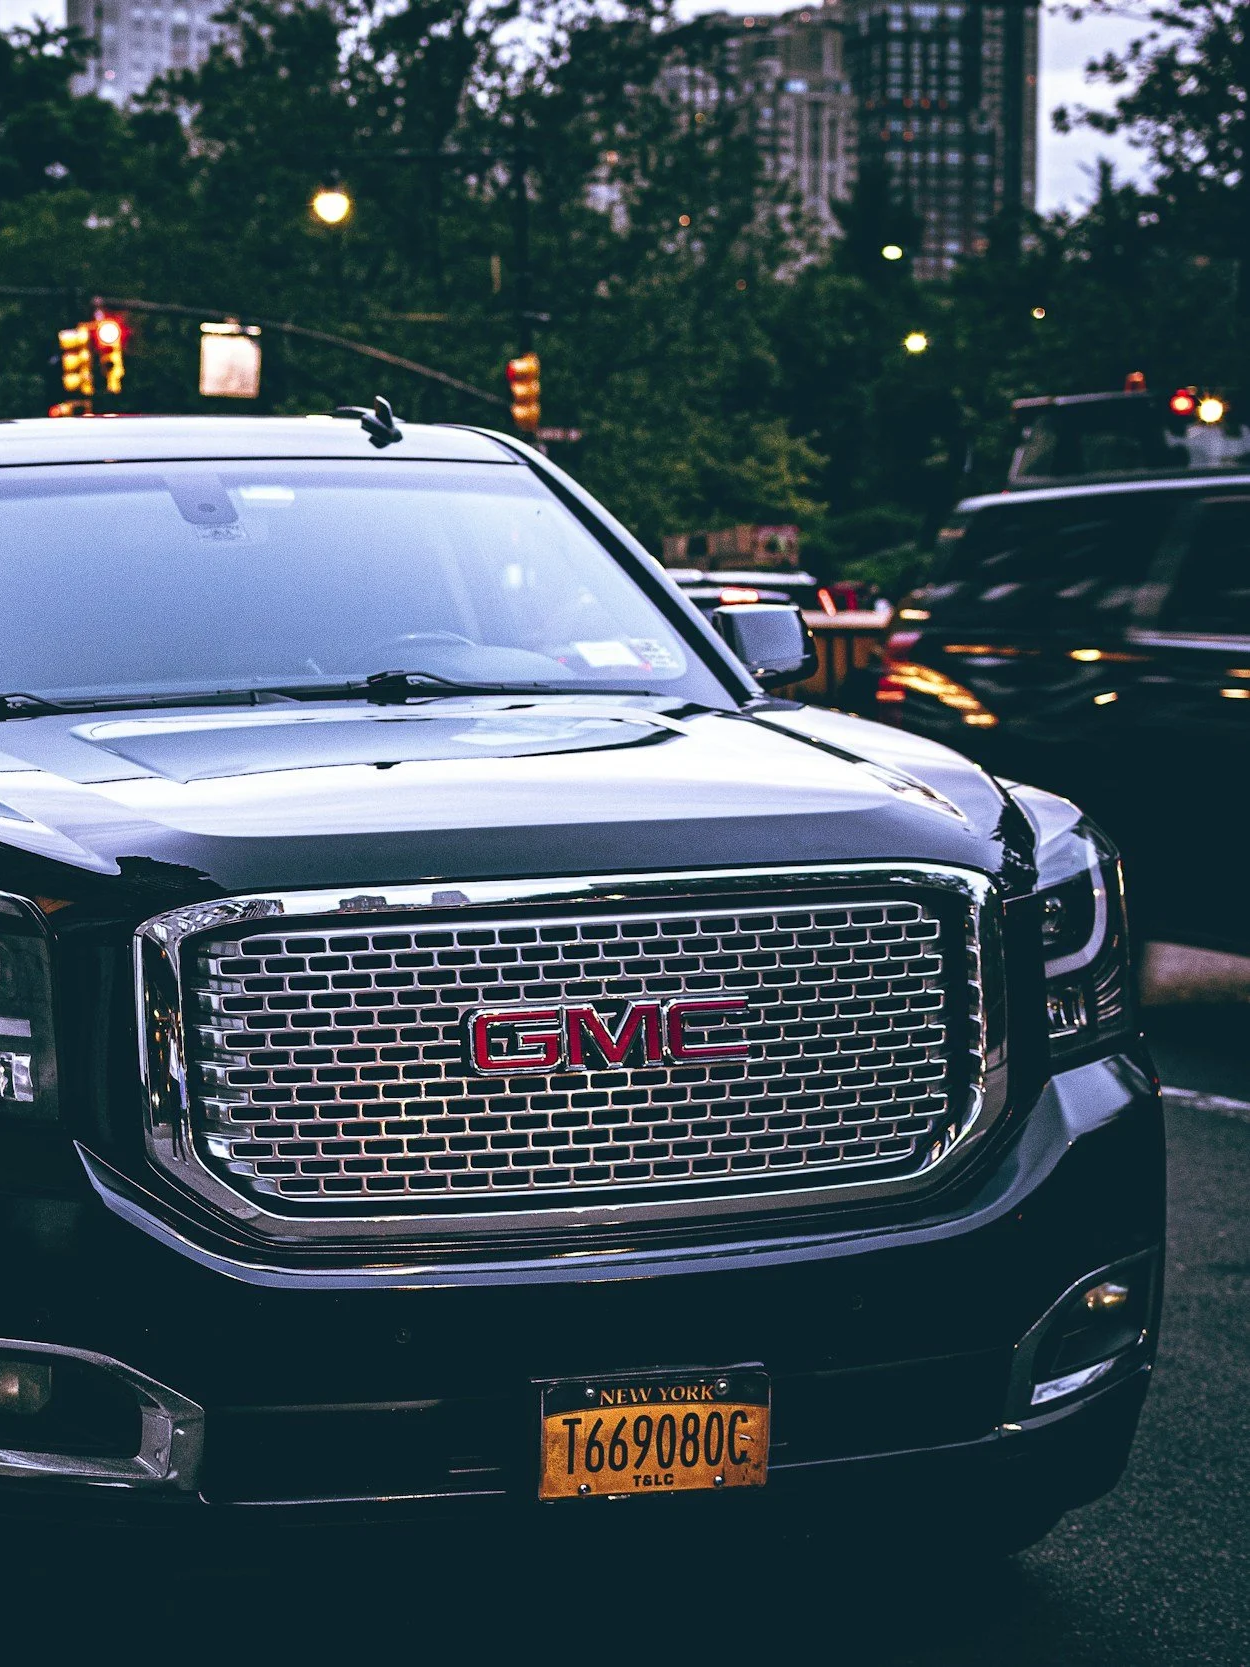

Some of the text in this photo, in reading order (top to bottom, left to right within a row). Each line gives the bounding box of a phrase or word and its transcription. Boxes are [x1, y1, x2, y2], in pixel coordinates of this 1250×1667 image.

[469, 997, 751, 1076] GMC
[600, 1384, 714, 1405] NEW YORK
[562, 1410, 748, 1475] T669080C
[633, 1473, 674, 1487] T&LC
